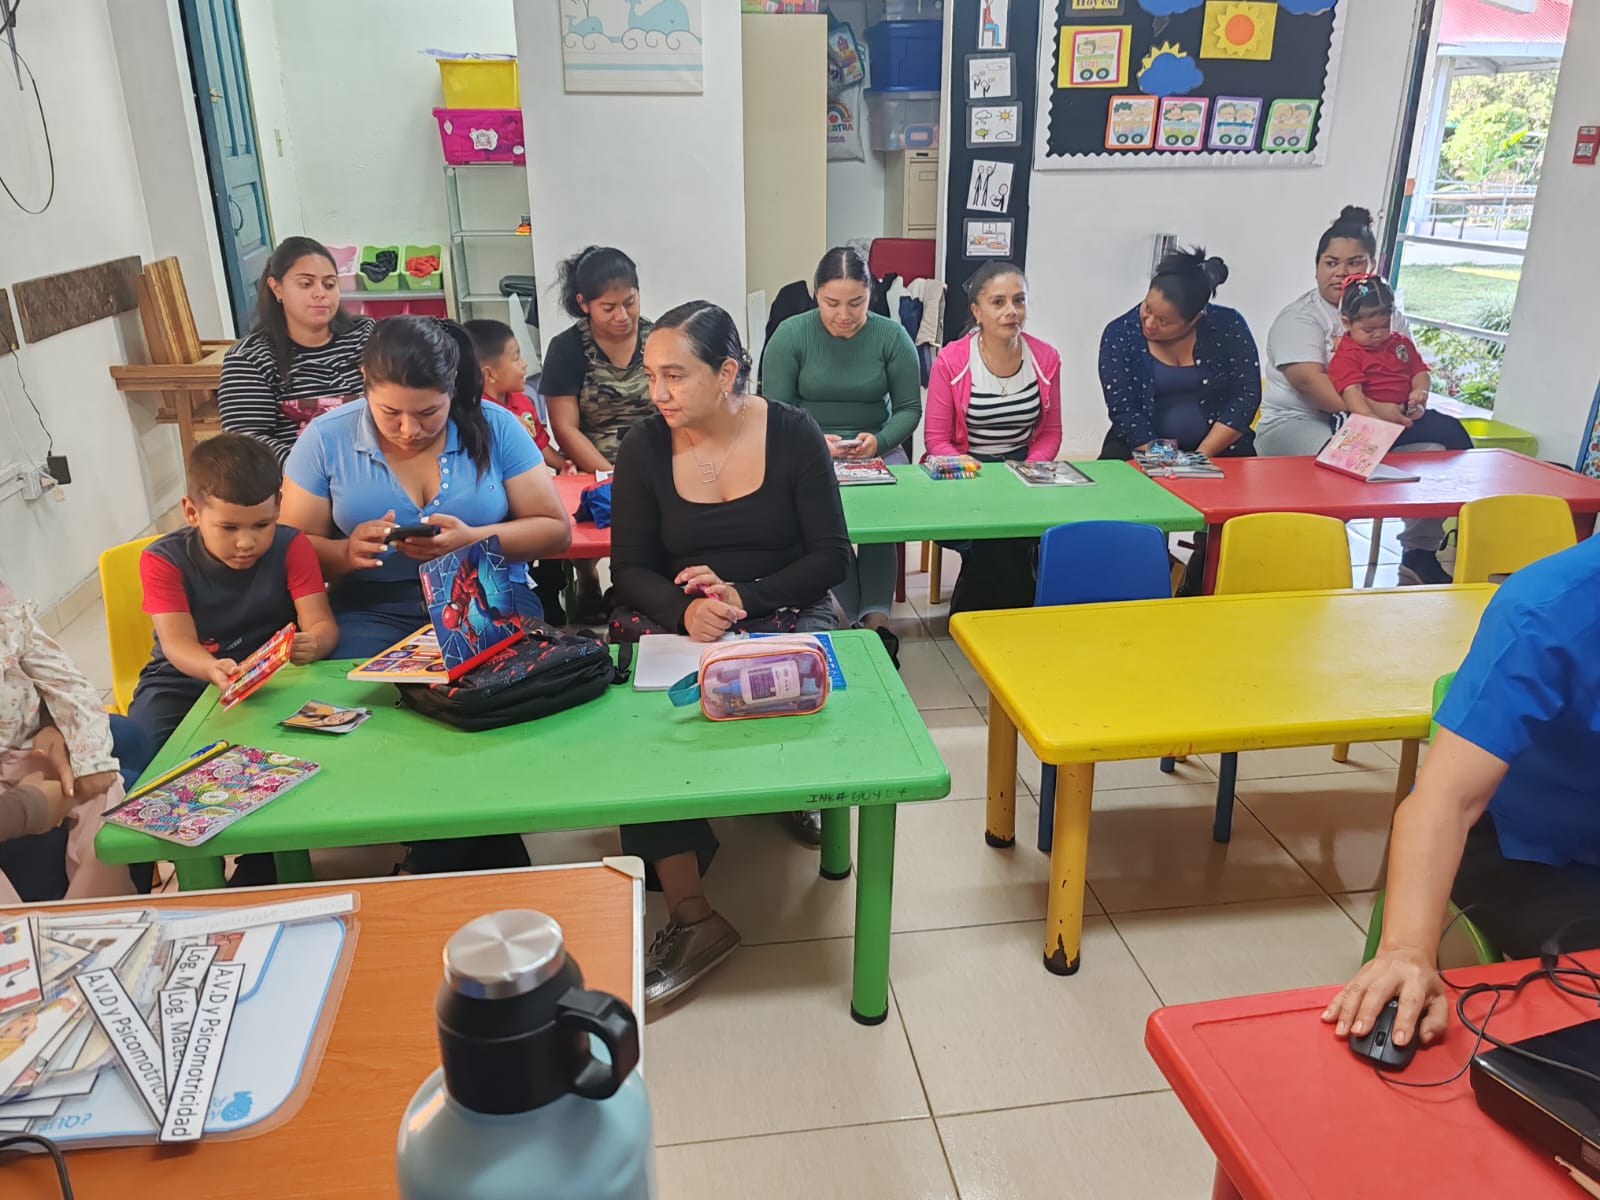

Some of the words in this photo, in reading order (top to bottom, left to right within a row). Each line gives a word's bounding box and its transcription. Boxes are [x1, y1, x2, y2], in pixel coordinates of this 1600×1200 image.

[84, 974, 119, 1007] A.V.D
[209, 968, 234, 1003] A.V.D
[101, 1009, 122, 1017] y
[164, 991, 189, 1018] Lóg.
[202, 1007, 220, 1016] y
[111, 1017, 167, 1113] Psicomotrici
[170, 1018, 221, 1137] Psicomotricidad
